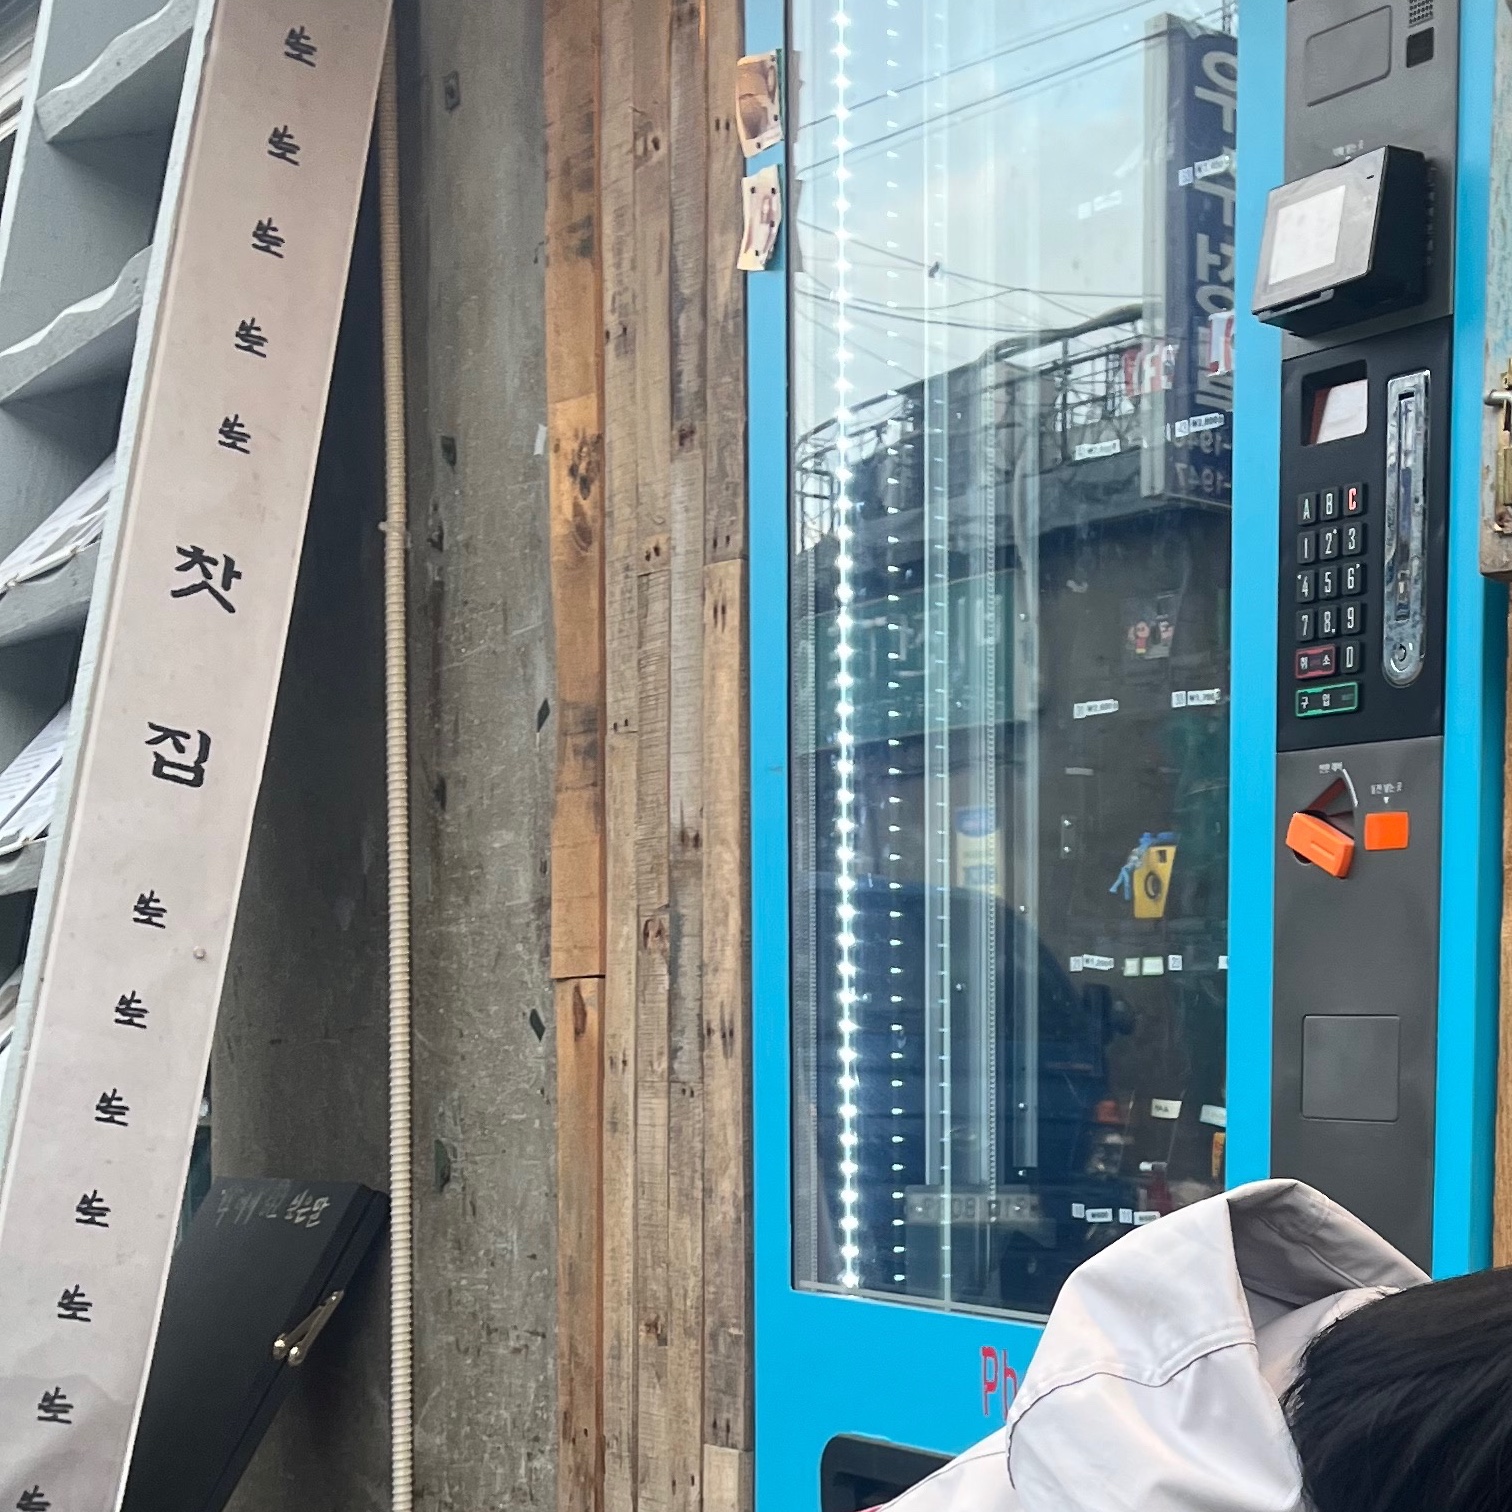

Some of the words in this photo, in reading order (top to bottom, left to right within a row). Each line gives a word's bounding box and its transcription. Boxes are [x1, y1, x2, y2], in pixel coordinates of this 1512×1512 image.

[1302, 497, 1311, 521] A
[1325, 492, 1333, 515] B
[1347, 487, 1357, 511] C
[1303, 537, 1309, 560] 1
[1324, 532, 1333, 555] 2
[1347, 527, 1356, 551] 3
[1301, 575, 1309, 598] 4
[1323, 571, 1332, 594] 5
[1346, 566, 1355, 590] 6
[1301, 614, 1309, 637] 7
[1323, 610, 1331, 634] 8
[1346, 606, 1354, 630] 9
[1345, 645, 1354, 669] 0
